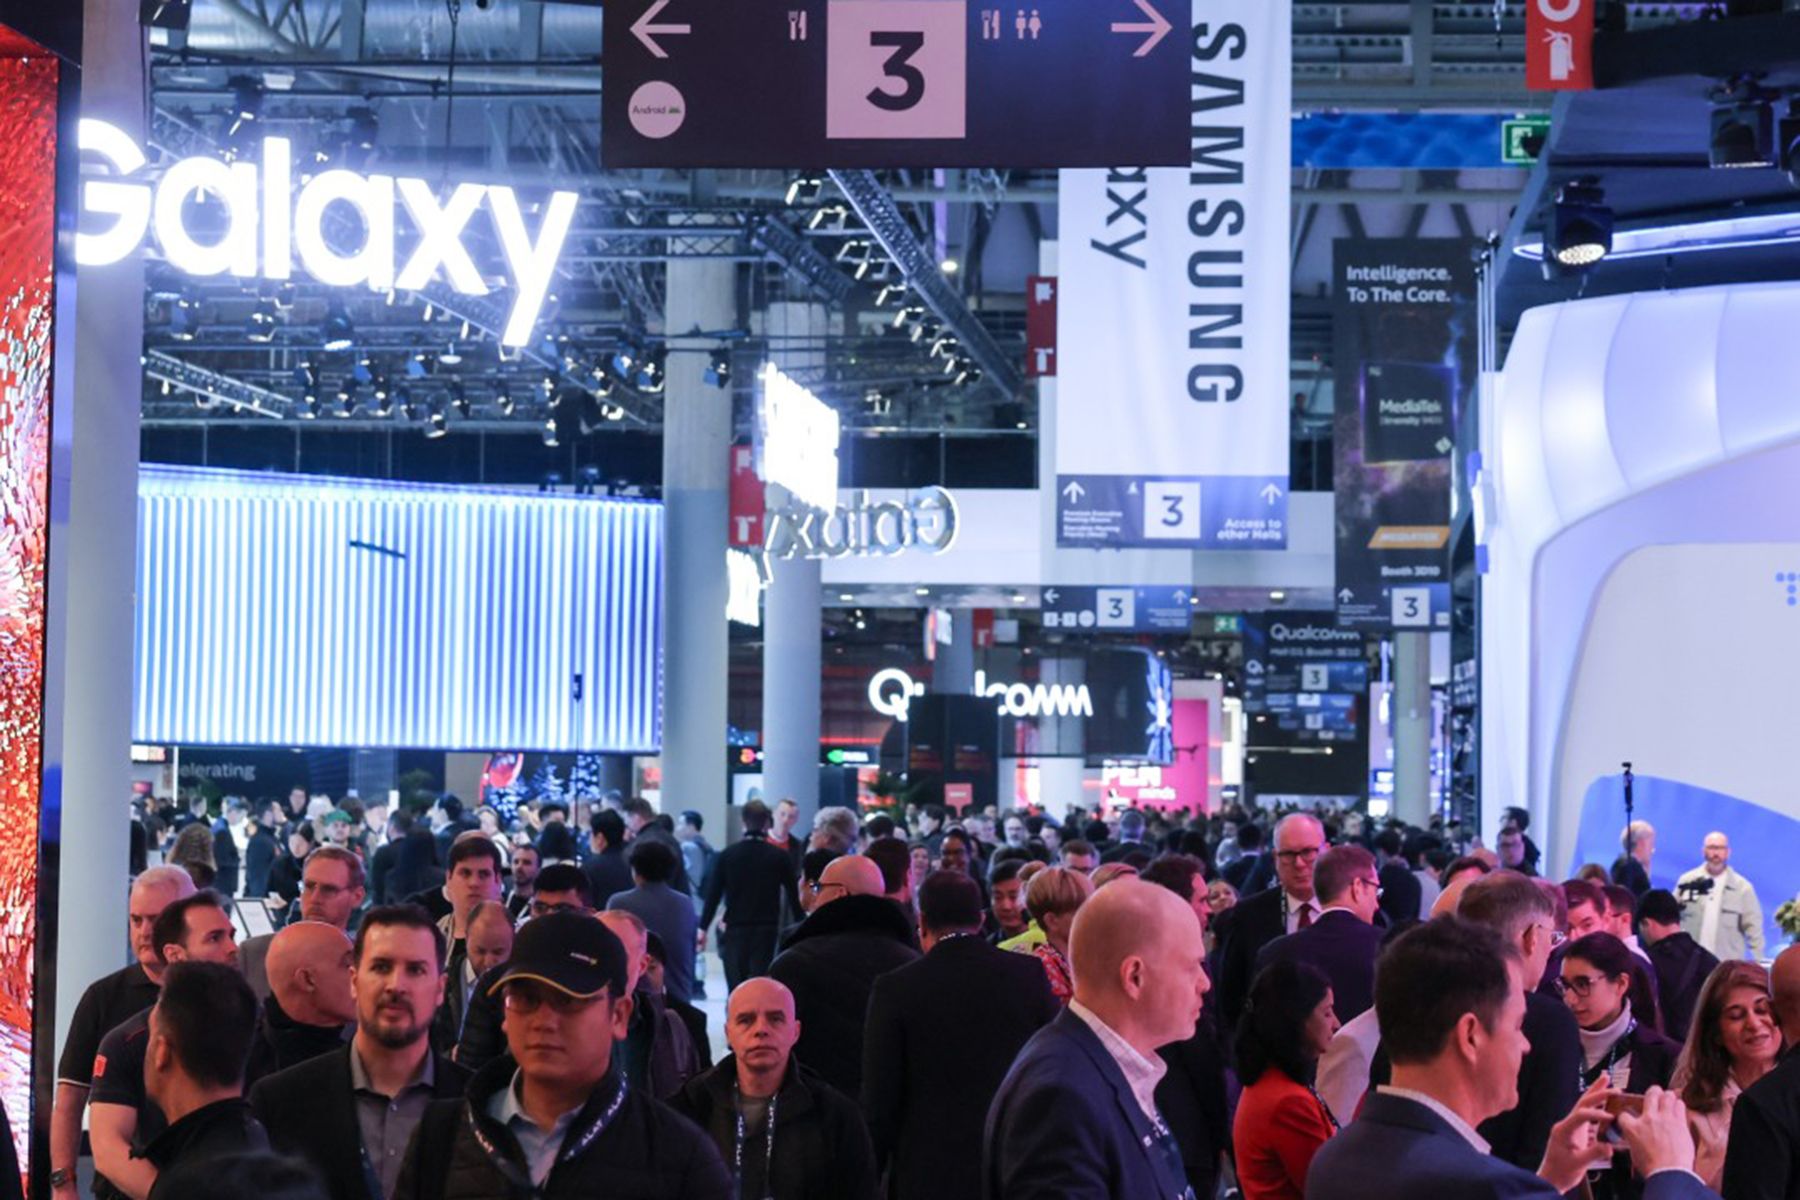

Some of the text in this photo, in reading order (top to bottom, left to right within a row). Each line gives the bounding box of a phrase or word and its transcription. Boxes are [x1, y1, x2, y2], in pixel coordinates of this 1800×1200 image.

[866, 31, 925, 111] 3
[632, 105, 667, 114] Android
[1188, 22, 1247, 403] SAMSUNG
[75, 118, 579, 347] Galaxy
[1346, 265, 1453, 285] Intelligence.
[1346, 286, 1451, 302] To The Core.
[1379, 399, 1442, 413] MediaTek
[1161, 495, 1184, 527] 3
[1225, 518, 1282, 529] Access to
[1217, 530, 1282, 541] other Halls
[1108, 597, 1123, 619] 3
[1403, 596, 1420, 618] 3
[1269, 623, 1362, 642] Qualcomm
[1311, 668, 1322, 686] 3
